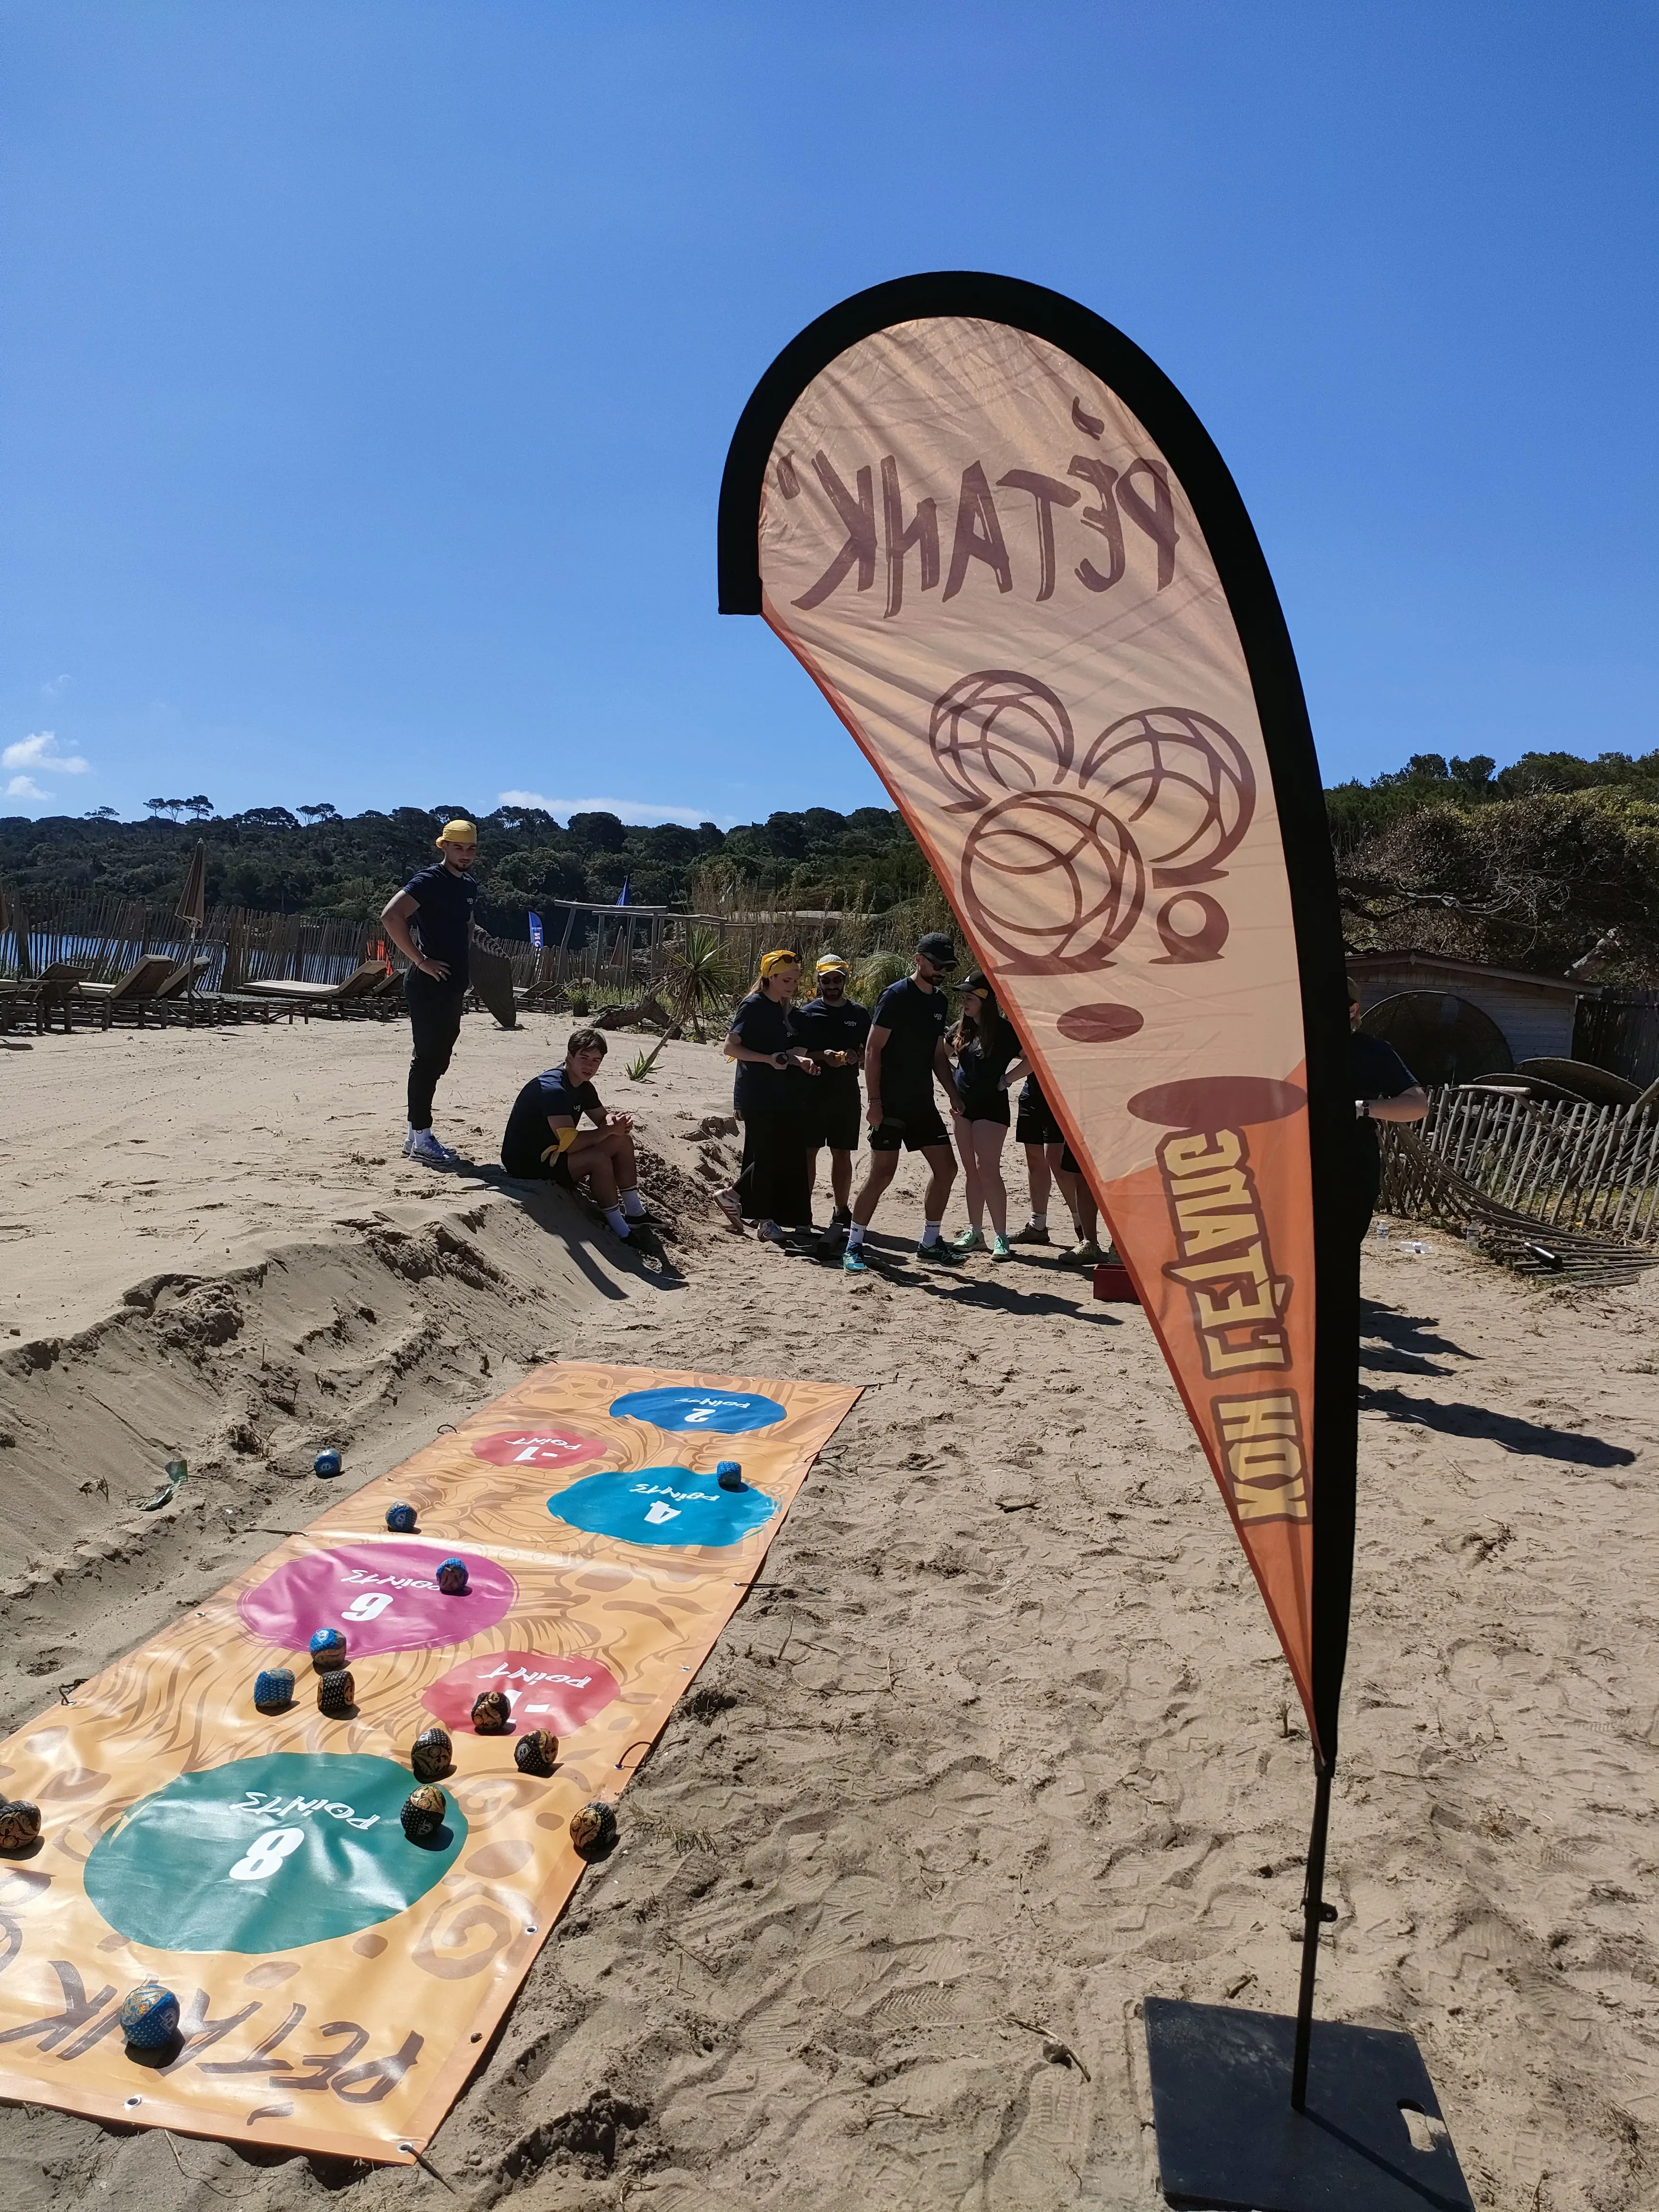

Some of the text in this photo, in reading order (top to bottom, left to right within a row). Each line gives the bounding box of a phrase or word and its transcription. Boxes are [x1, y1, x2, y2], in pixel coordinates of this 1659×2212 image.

[684, 1408, 717, 1423] 2
[513, 1446, 559, 1461] -1
[643, 1500, 682, 1524] 4
[341, 1592, 394, 1621] 6
[229, 1827, 305, 1880] 8
